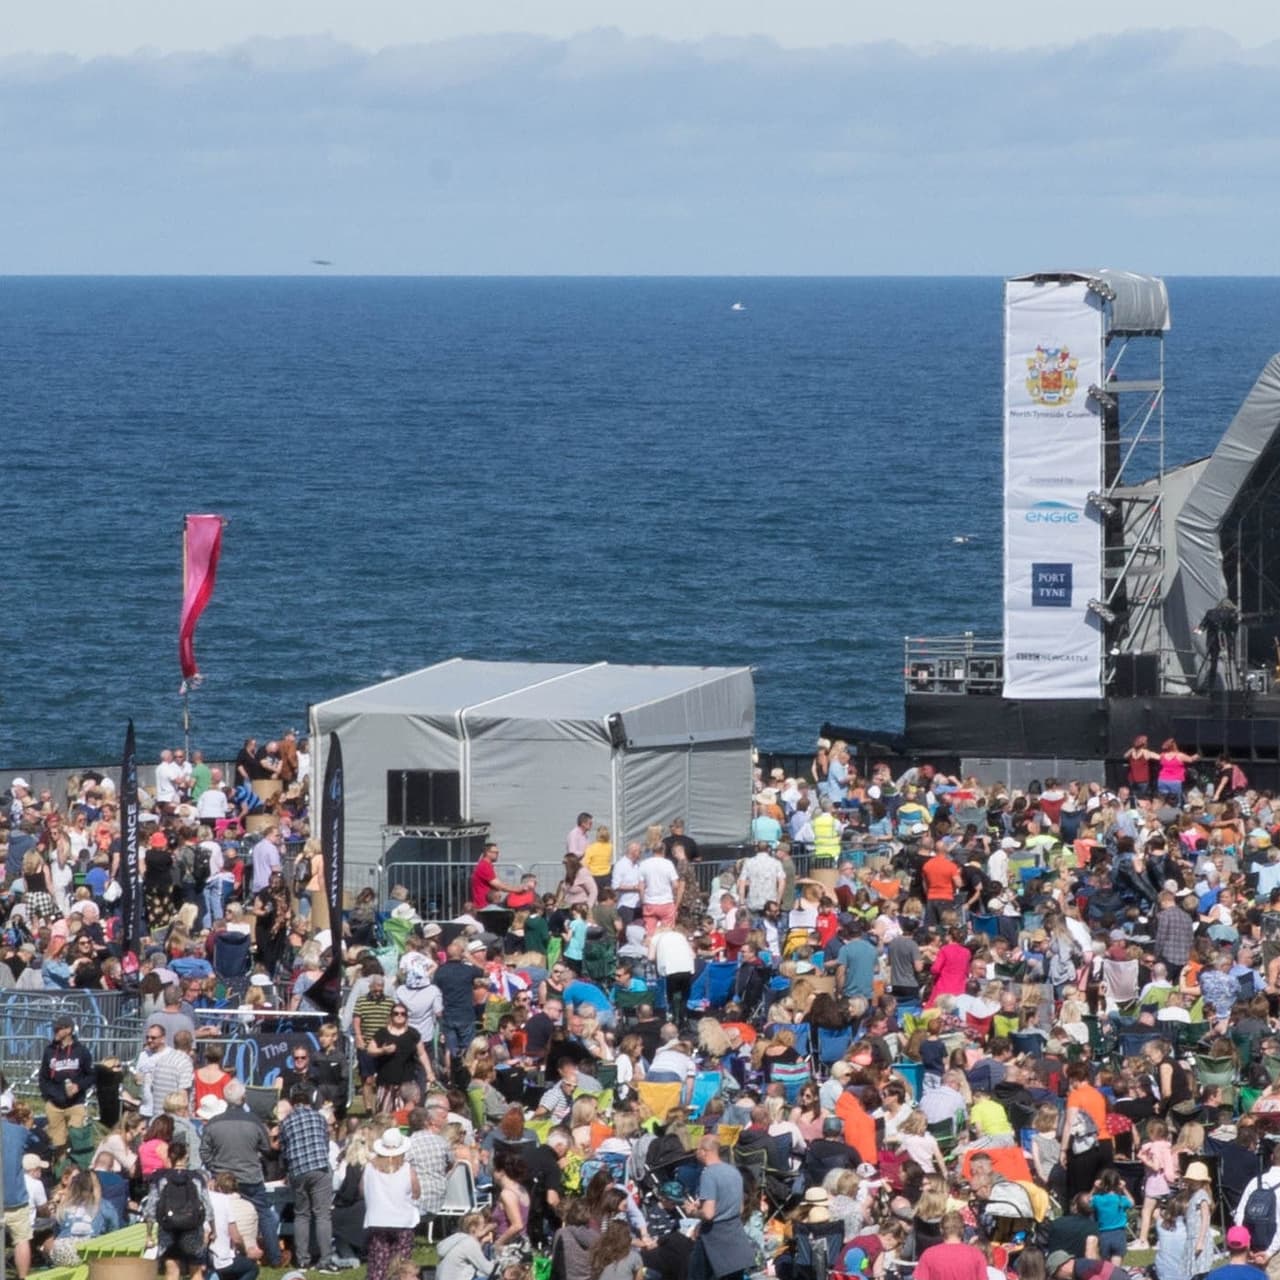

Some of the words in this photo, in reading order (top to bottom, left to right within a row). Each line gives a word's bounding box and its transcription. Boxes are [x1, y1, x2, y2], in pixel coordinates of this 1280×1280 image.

[1038, 572, 1066, 583] PORT
[1039, 588, 1066, 598] TYNE
[261, 1040, 288, 1059] The
